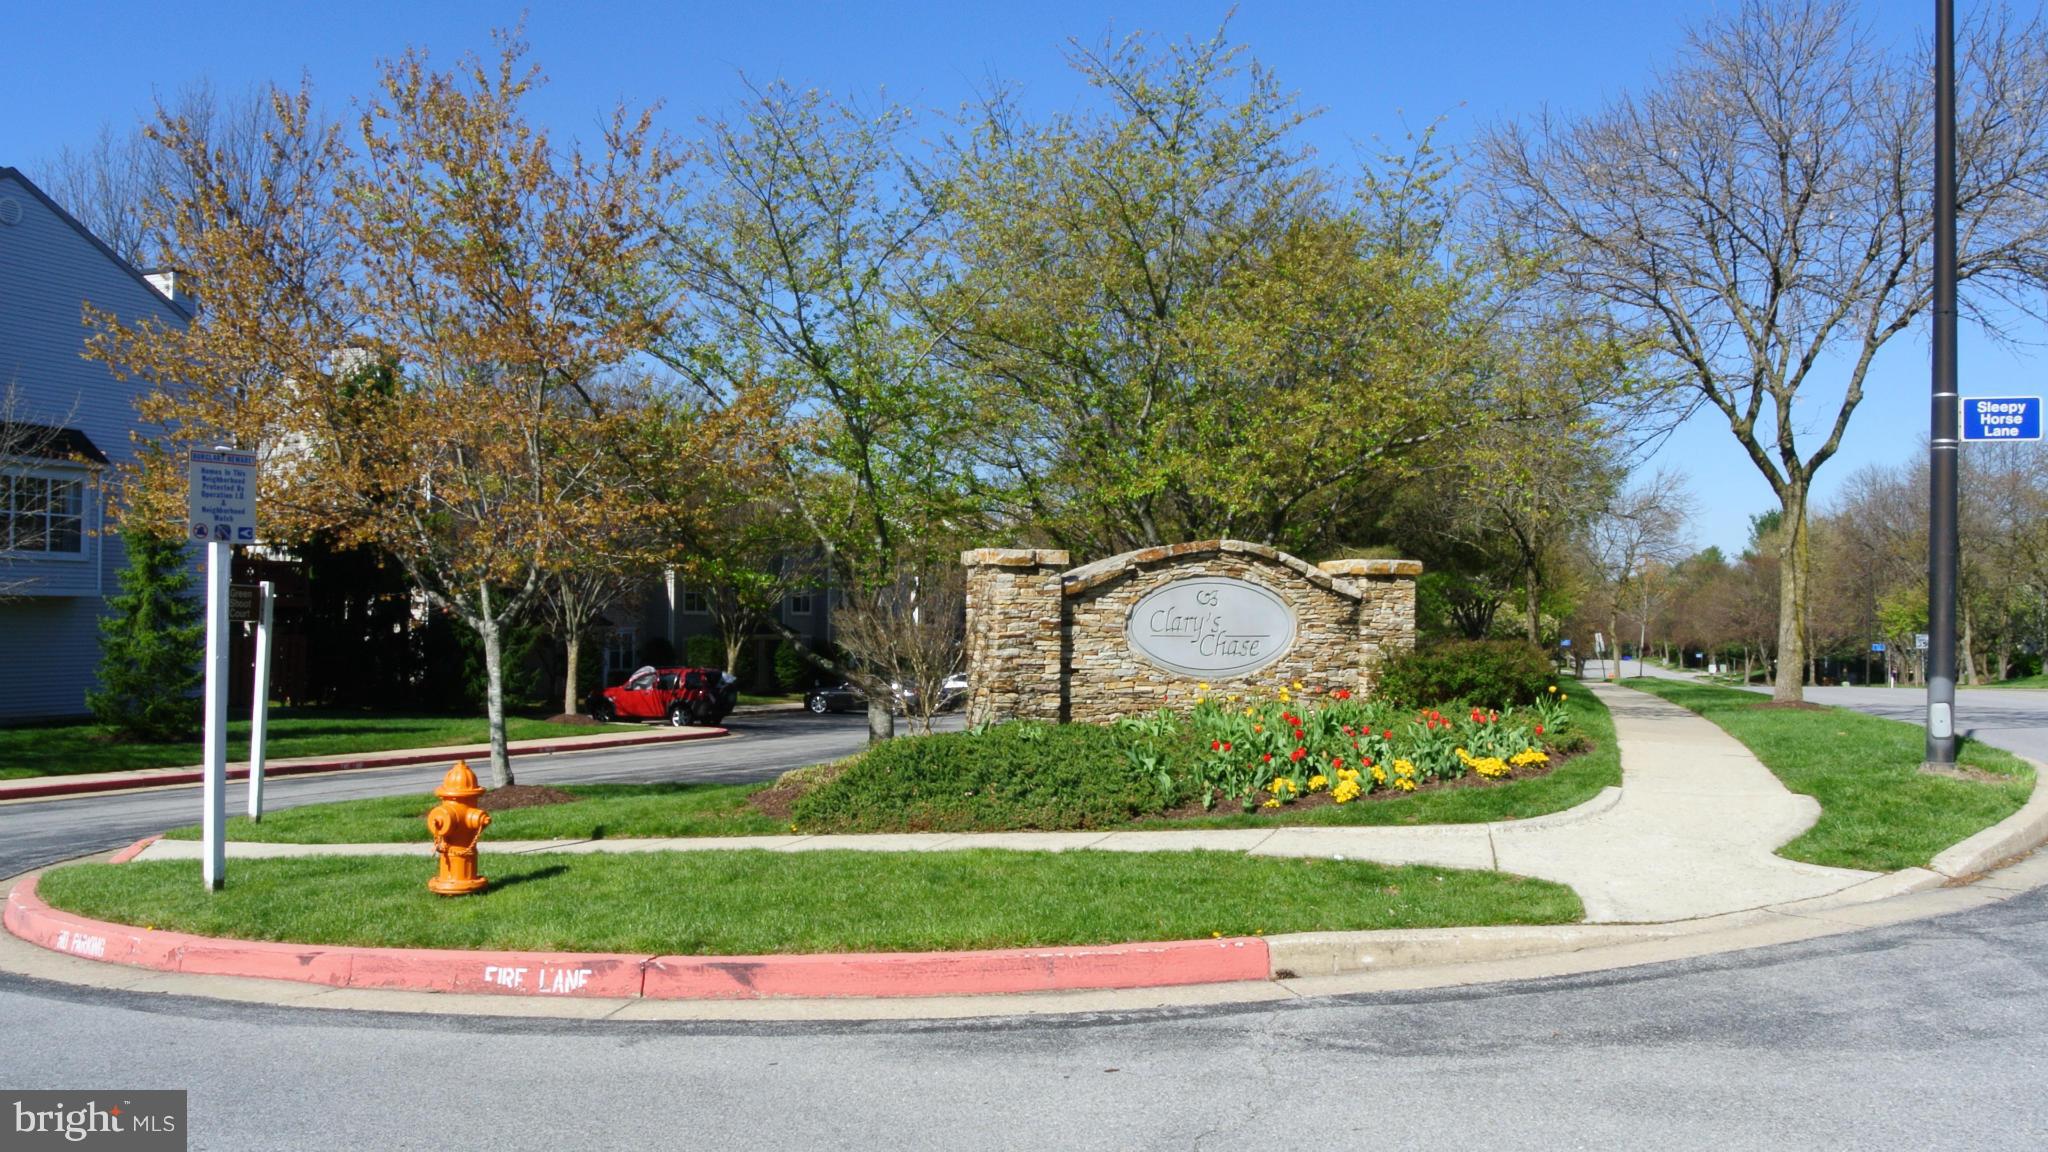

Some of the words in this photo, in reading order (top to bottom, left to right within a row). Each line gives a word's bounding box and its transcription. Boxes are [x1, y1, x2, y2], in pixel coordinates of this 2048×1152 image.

[1976, 401, 2026, 414] Sleepy
[1980, 413, 2023, 425] Horse
[1984, 425, 2020, 437] Lane
[201, 467, 222, 475] Homes
[233, 469, 246, 477] This
[201, 475, 246, 484] Neighborhood
[202, 483, 234, 491] Protected
[201, 490, 233, 499] Operation
[201, 506, 246, 515] Neighborhood
[214, 514, 234, 522] Watch
[231, 588, 252, 598] Green
[230, 598, 251, 608] Shoot
[230, 608, 250, 618] Court
[1150, 606, 1222, 643] Clary's
[1199, 630, 1261, 657] Chase
[484, 966, 528, 991] FIRE
[539, 968, 592, 993] LANE
